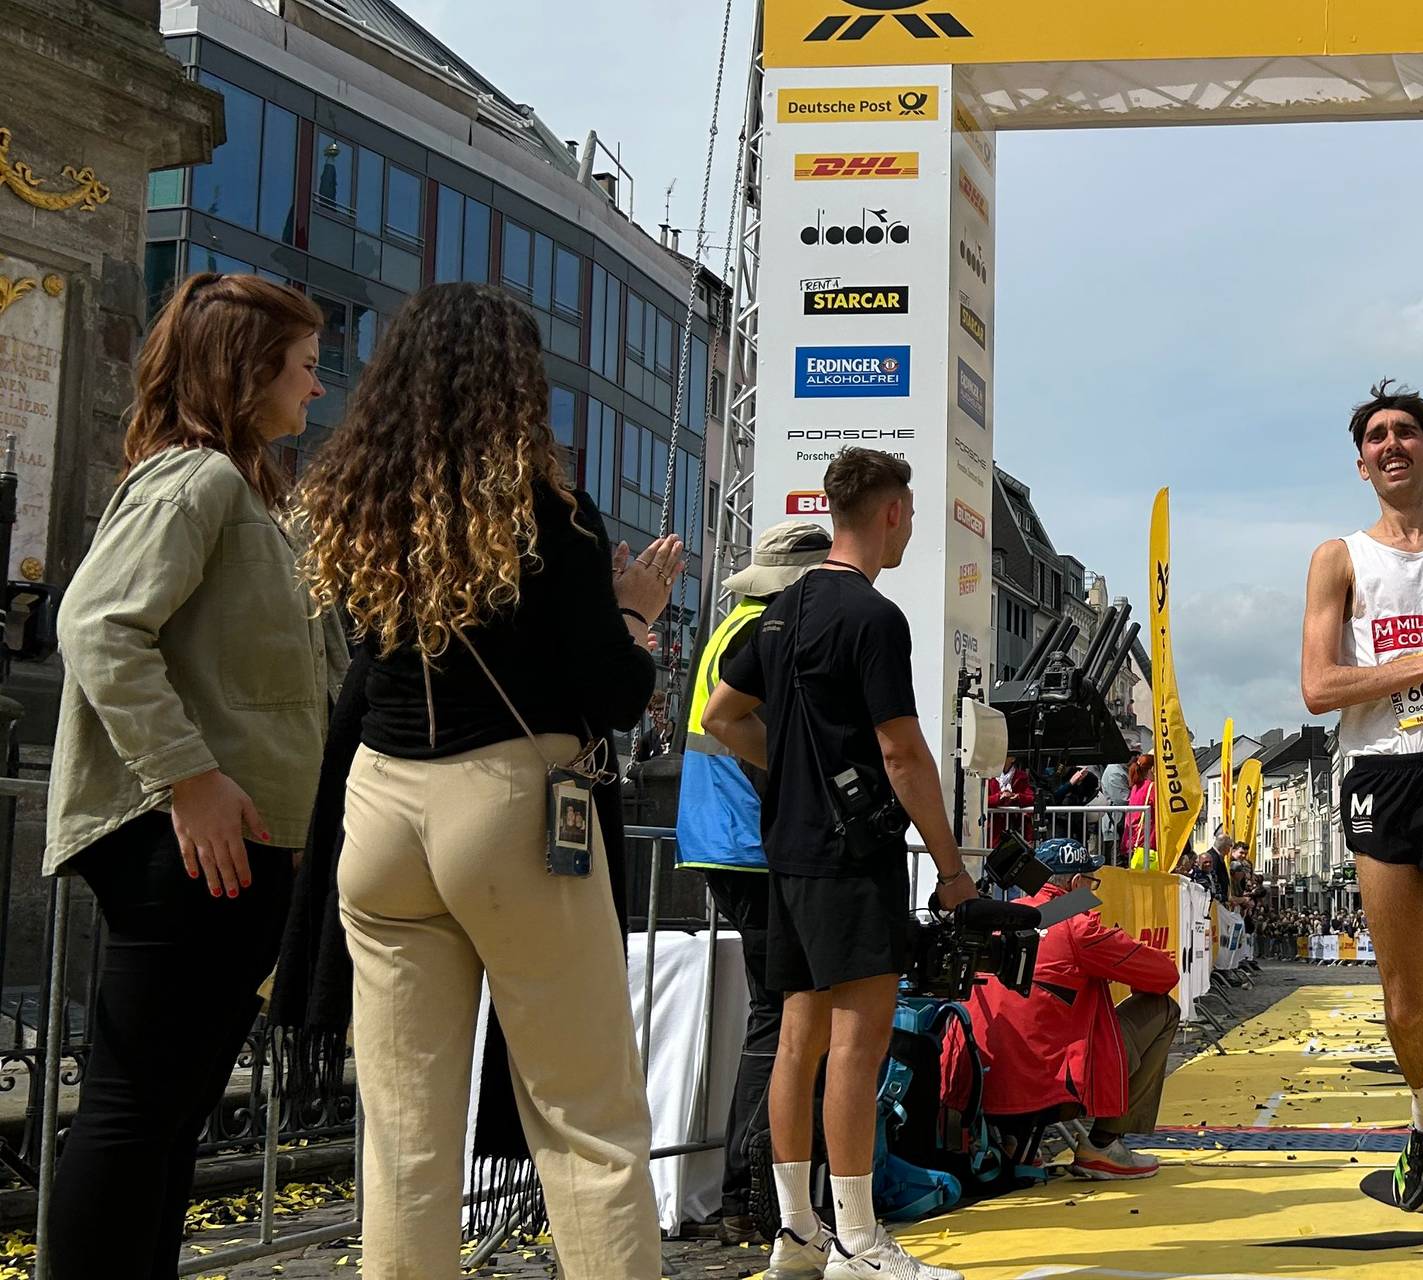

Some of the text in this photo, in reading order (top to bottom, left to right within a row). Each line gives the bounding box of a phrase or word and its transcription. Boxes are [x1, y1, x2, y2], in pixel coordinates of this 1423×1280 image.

[788, 100, 892, 114] Deutsche Post
[811, 156, 902, 176] DHL
[800, 207, 910, 245] diadora
[805, 281, 831, 291] RENT
[814, 292, 900, 309] STARCAR
[807, 358, 880, 374] ERDINGER
[806, 374, 899, 384] ALKOHOLFREI
[787, 429, 915, 440] PORSCHE
[797, 452, 835, 460] Porsche
